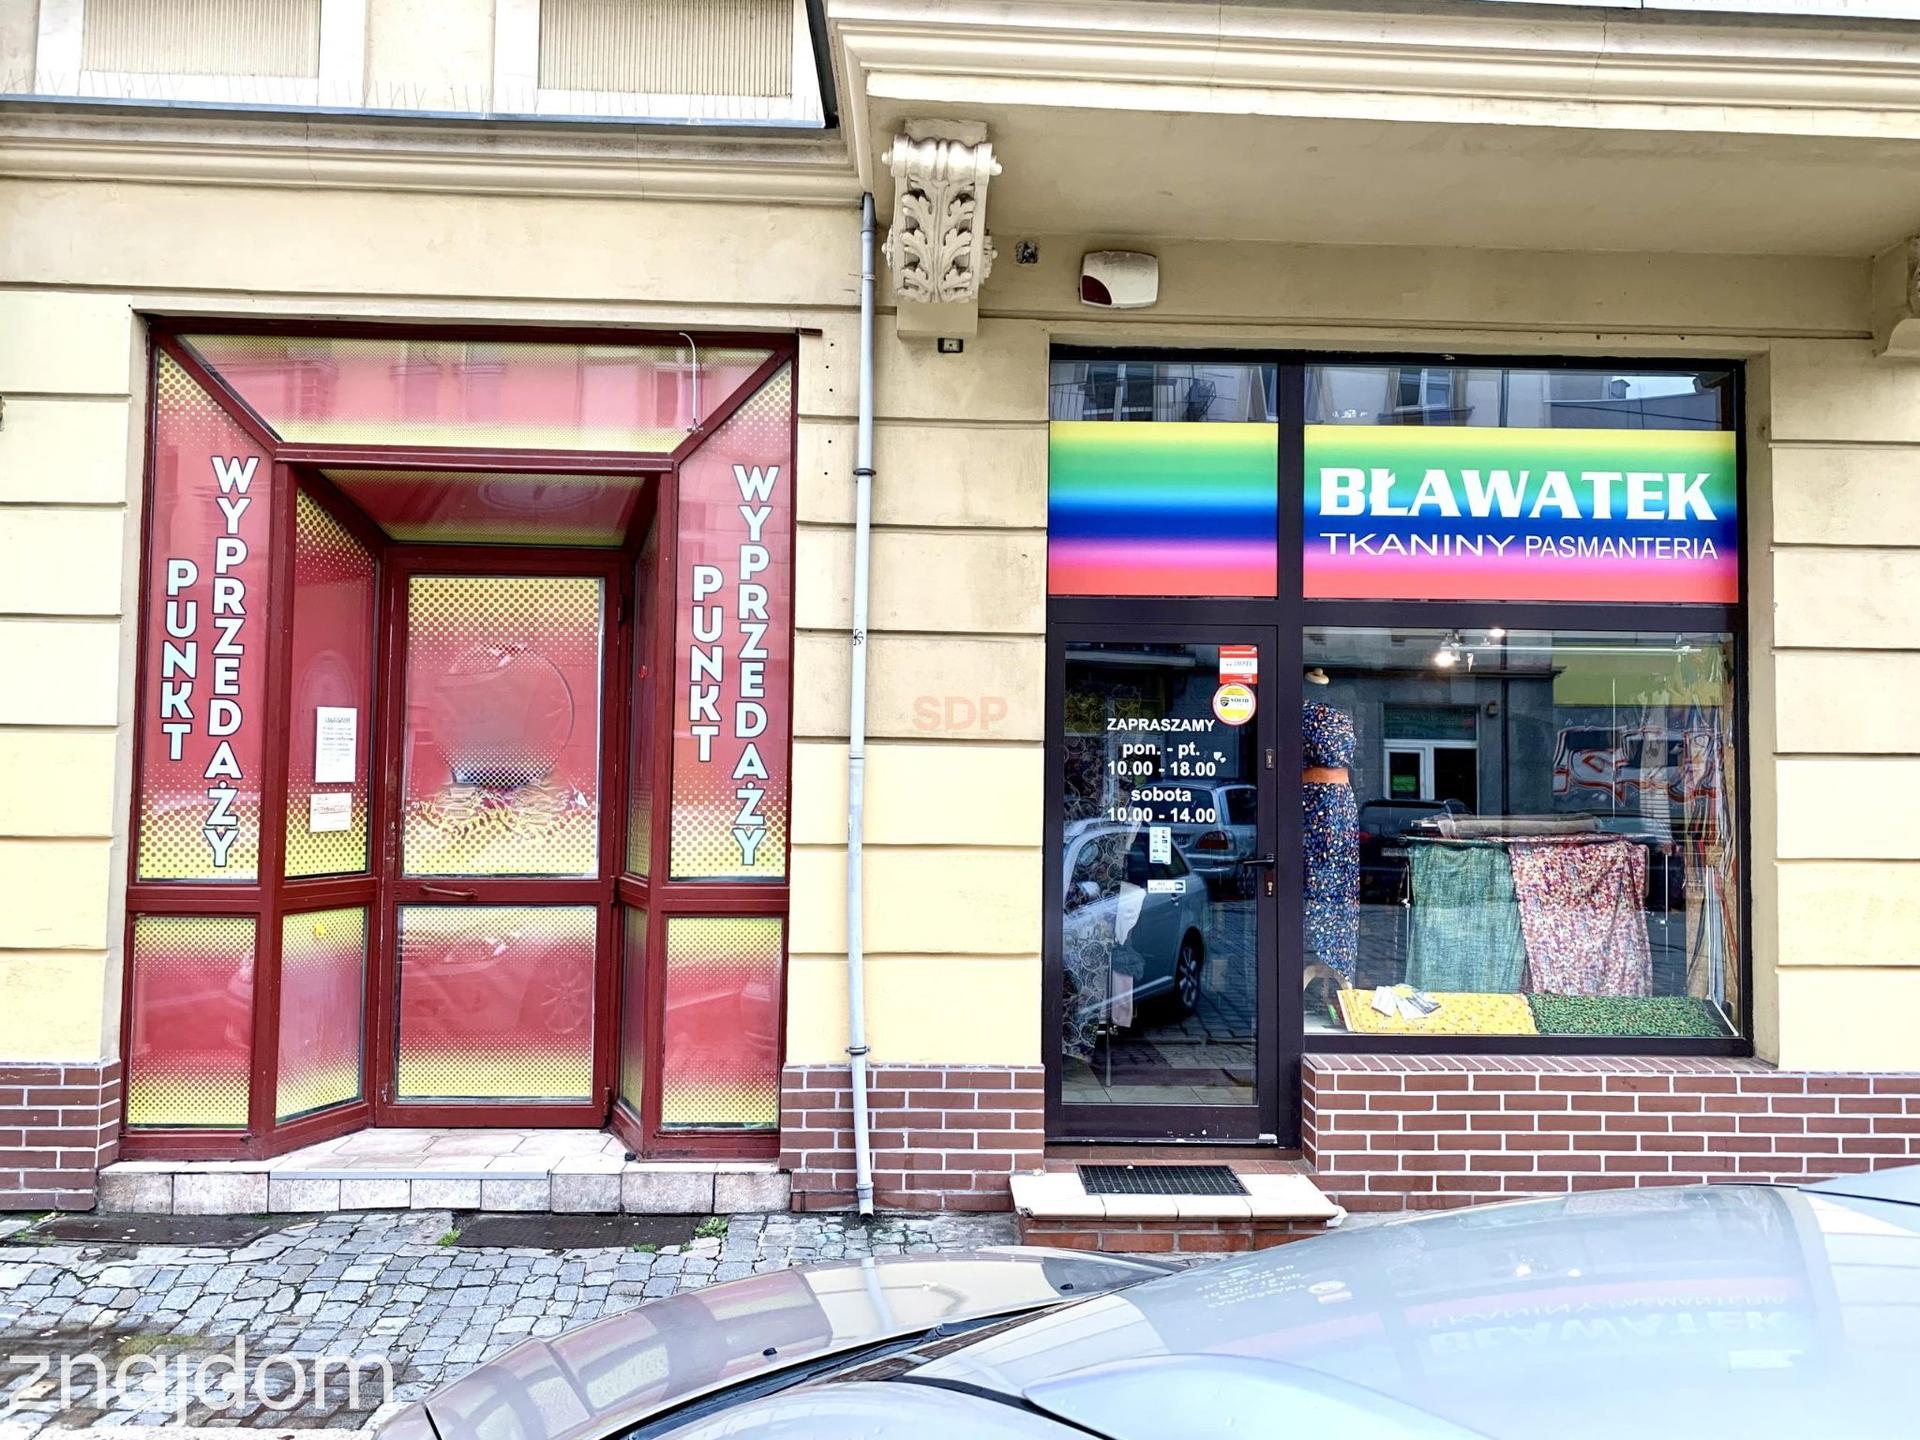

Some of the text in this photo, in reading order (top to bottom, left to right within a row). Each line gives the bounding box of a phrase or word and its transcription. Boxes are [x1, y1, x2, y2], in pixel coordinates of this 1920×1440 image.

[1319, 467, 1718, 521] BŁAWATEK
[1319, 532, 1719, 560] TKANINY PASMANTERIA
[160, 558, 199, 761] PUNKT
[203, 456, 260, 867] WYPRZEDAŻY
[689, 565, 723, 762] PUNKT
[732, 464, 780, 866] WYPRZEDAŻY
[1106, 718, 1216, 733] ZAPRASZAMY
[1122, 742, 1162, 759] pon.
[1178, 741, 1200, 760] pt.
[1107, 761, 1154, 776] 10.00
[1170, 761, 1216, 777] 18.00
[1131, 786, 1192, 802] sobota
[1107, 807, 1154, 822] 10.00
[1170, 807, 1216, 823] 14.00
